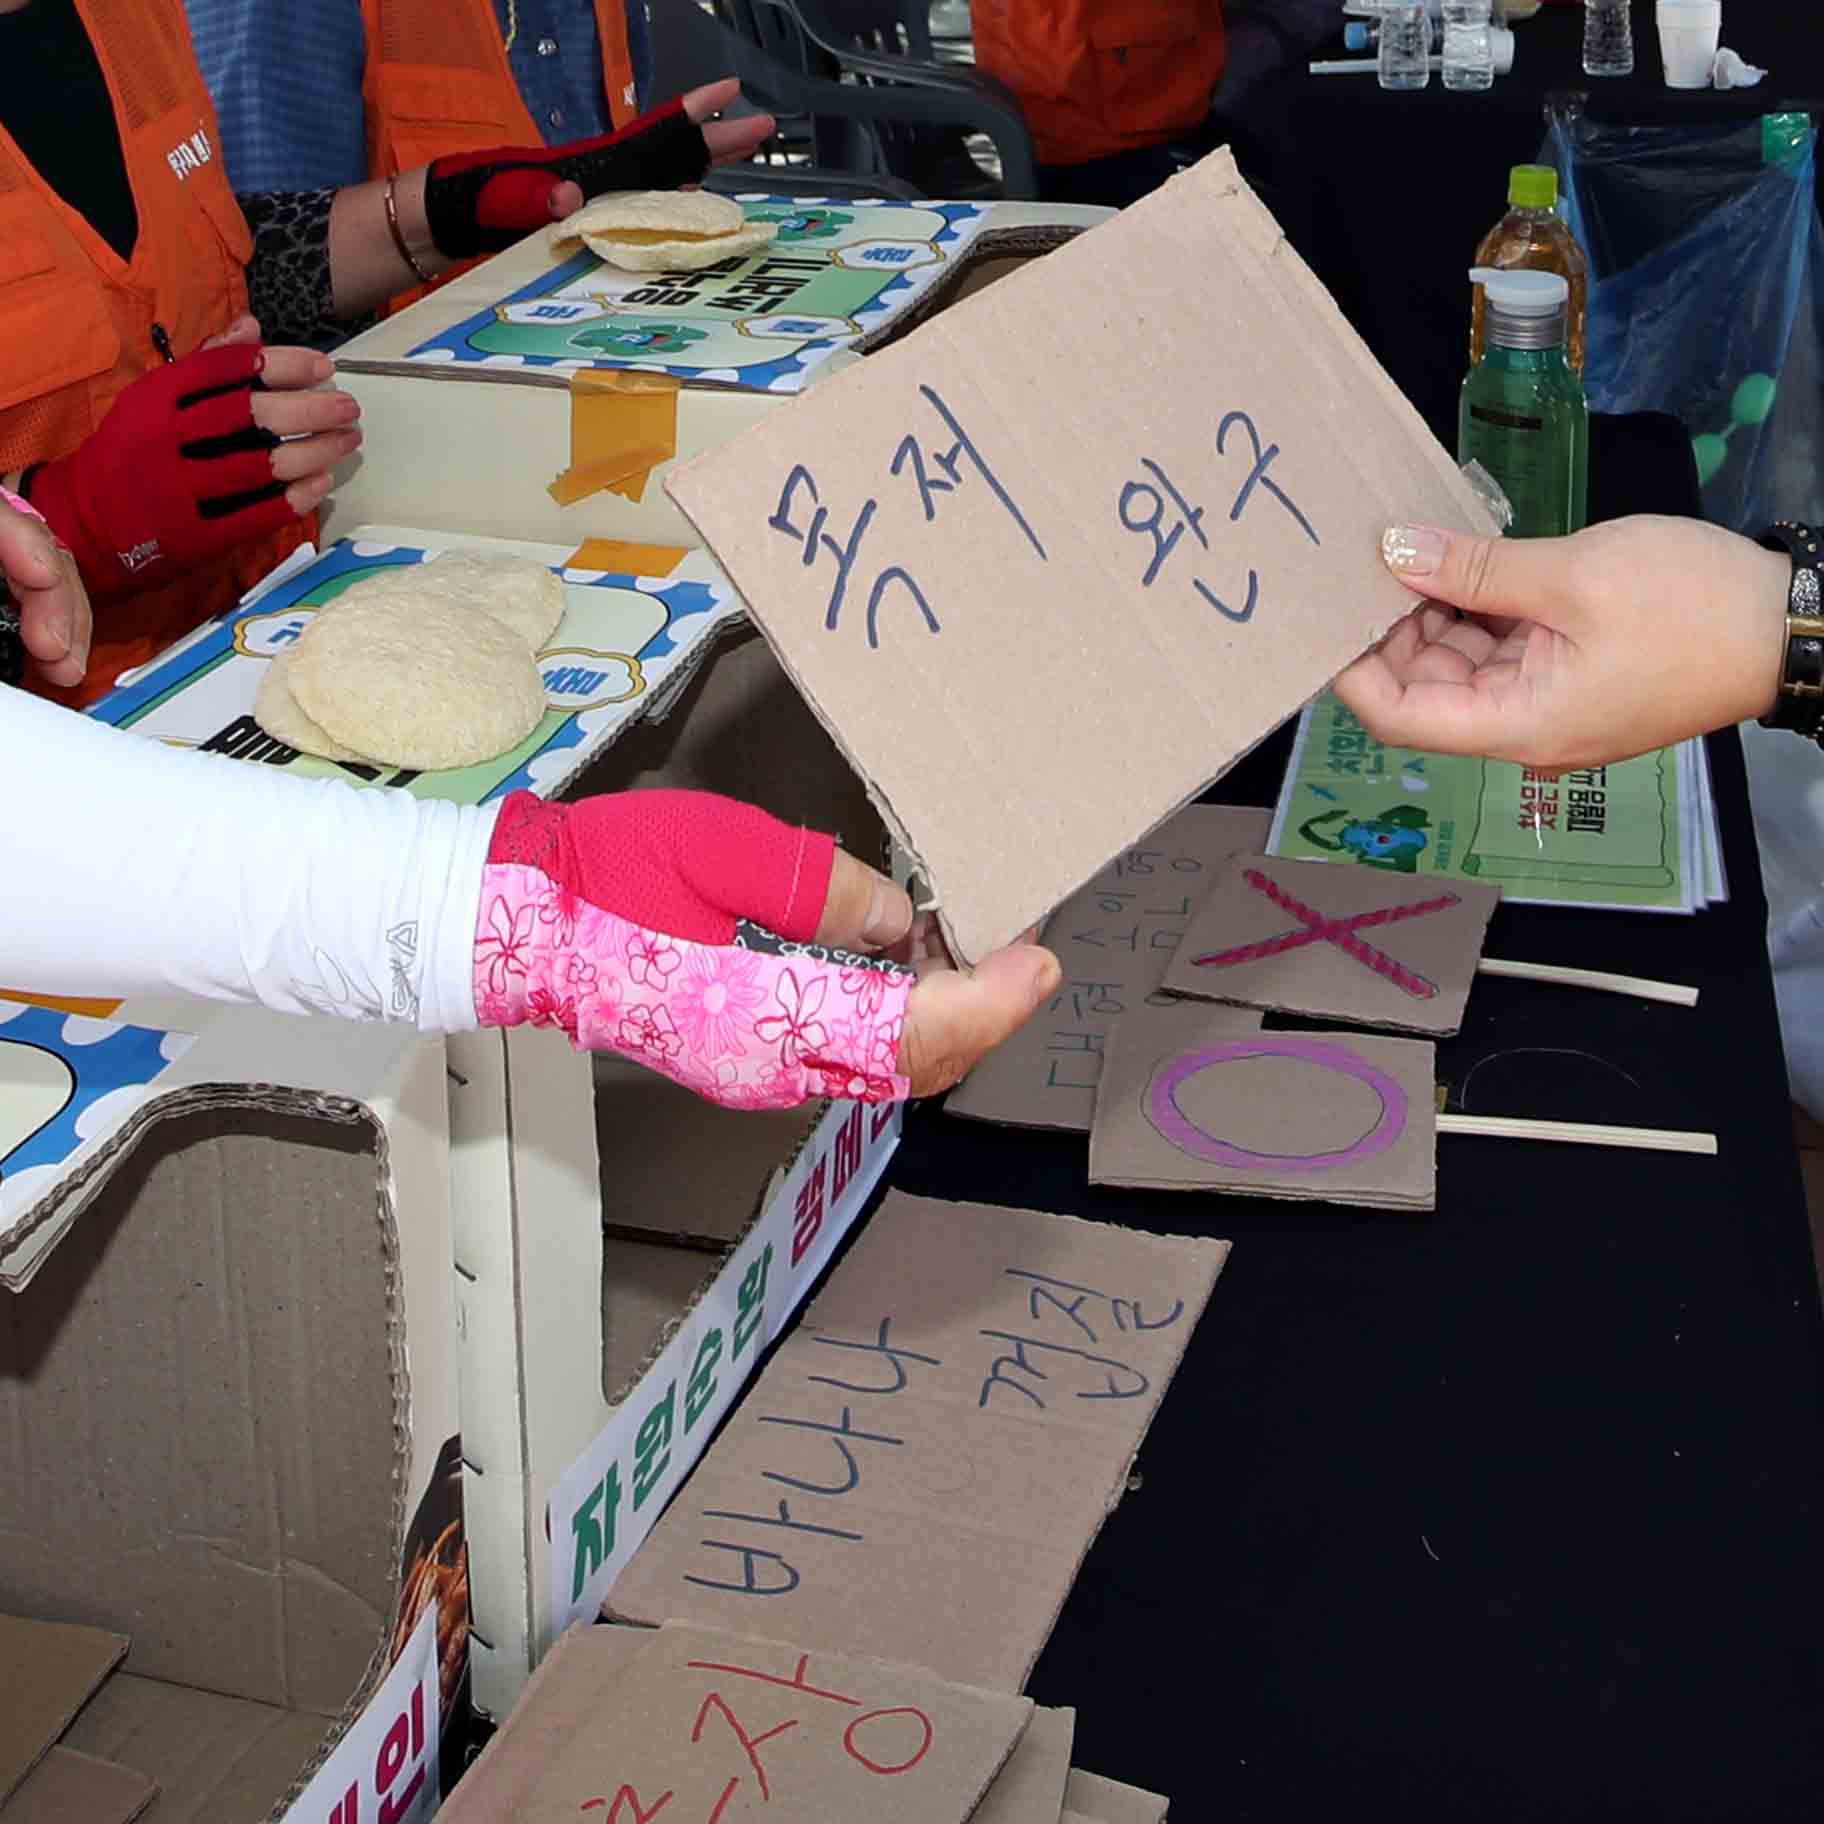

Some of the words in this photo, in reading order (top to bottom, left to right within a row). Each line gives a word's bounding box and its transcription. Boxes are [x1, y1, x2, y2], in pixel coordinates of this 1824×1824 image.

[702, 255, 830, 315] 쓰레기
[768, 383, 1049, 651] 목재
[1117, 408, 1322, 626] 완구
[570, 1240, 774, 1606] 자원순환
[682, 1316, 940, 1596] 바나나
[977, 1268, 1185, 1412] 껍질
